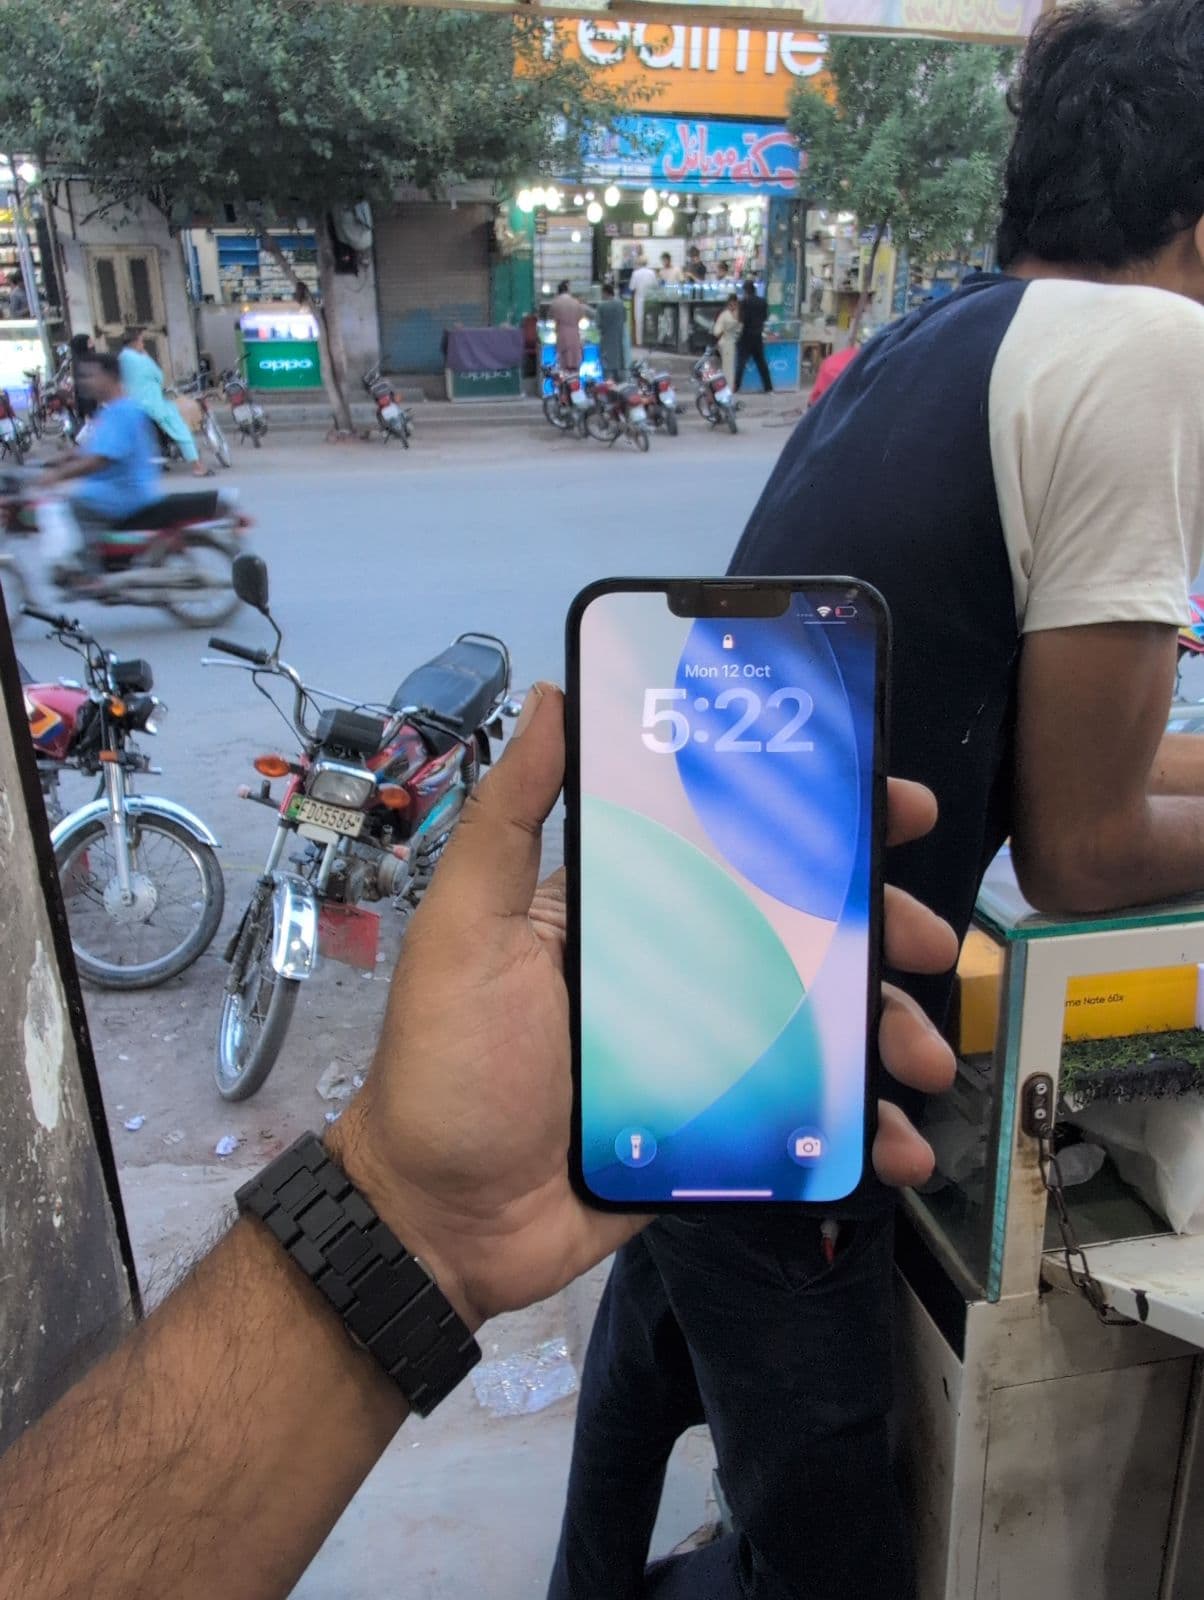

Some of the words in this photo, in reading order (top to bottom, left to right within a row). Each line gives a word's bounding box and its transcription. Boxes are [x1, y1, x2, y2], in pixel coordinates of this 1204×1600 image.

[684, 664, 718, 678] Mon
[722, 664, 740, 678] 12
[743, 664, 771, 678] Oct
[641, 687, 814, 754] 5:22
[1064, 999, 1081, 1007] me
[1083, 995, 1105, 1005] Note
[1107, 993, 1124, 1003] 60x
